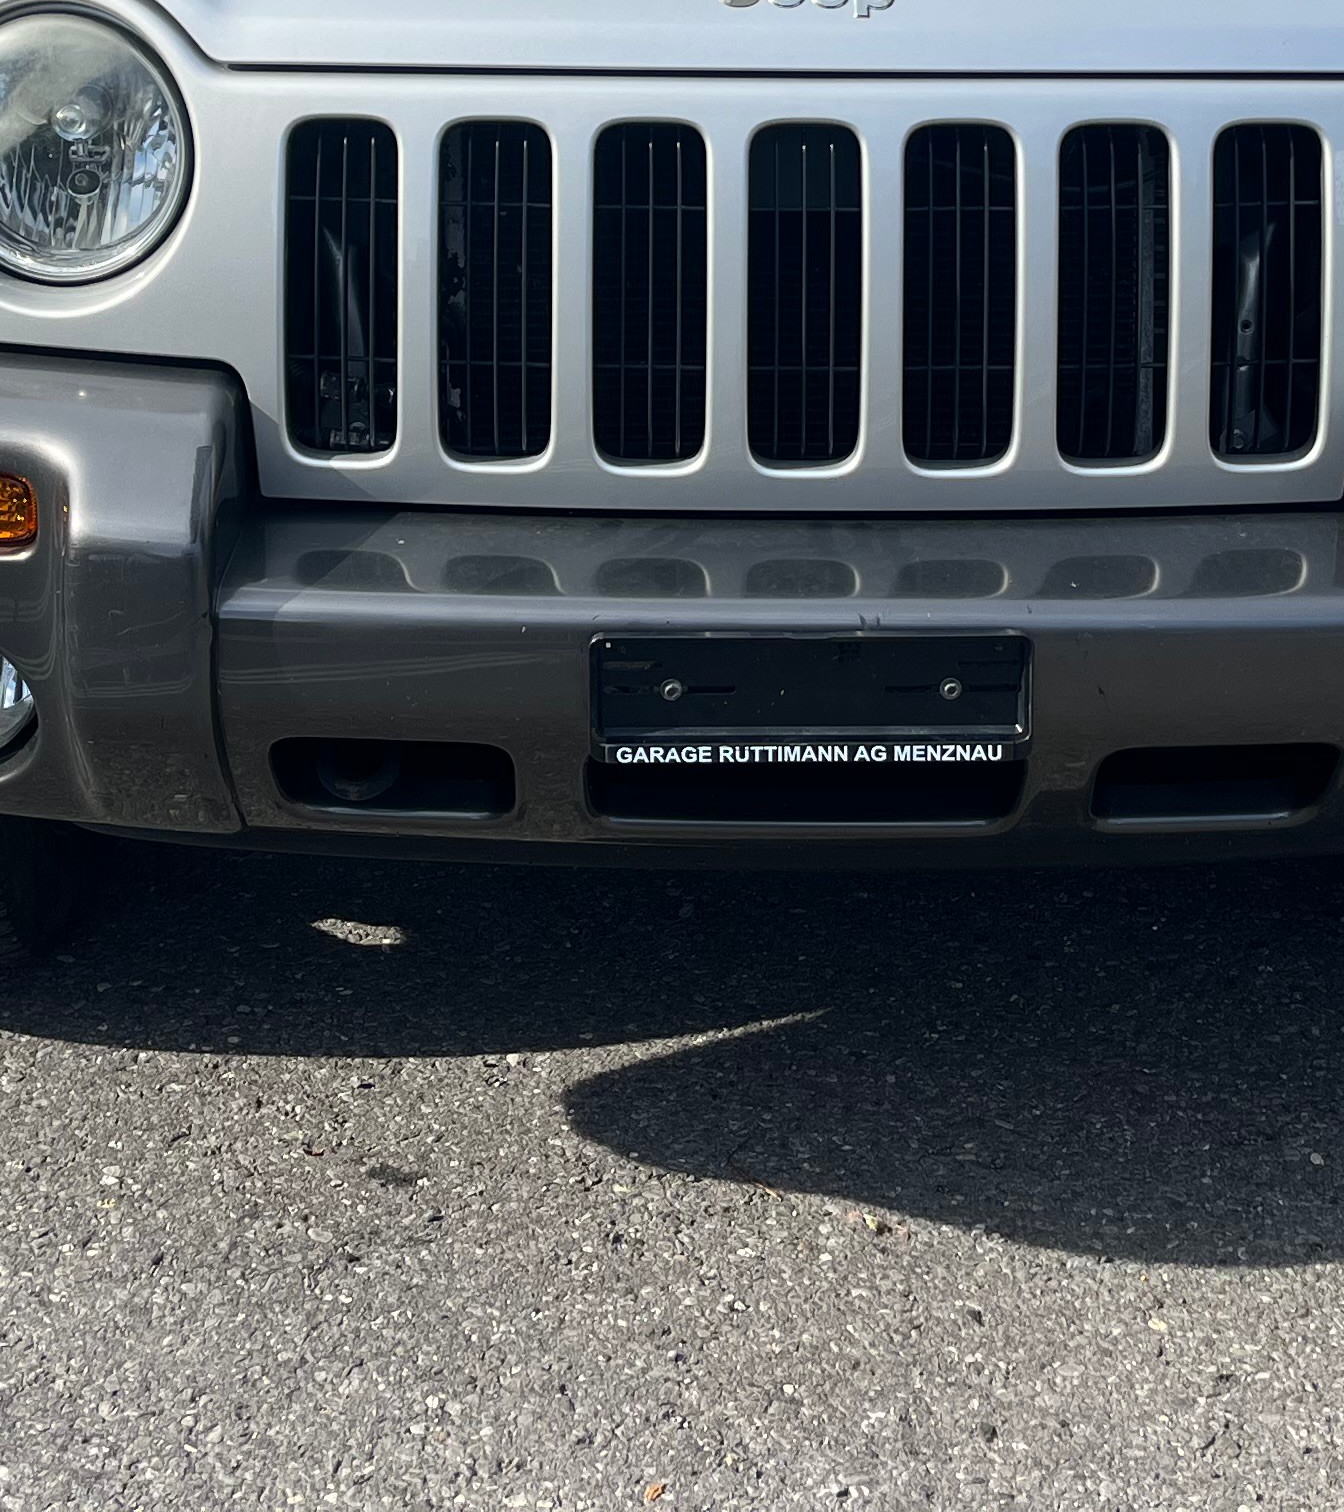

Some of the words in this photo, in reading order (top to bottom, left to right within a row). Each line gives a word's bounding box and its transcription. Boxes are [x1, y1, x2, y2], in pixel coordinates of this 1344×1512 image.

[616, 745, 713, 764] GARAGE
[853, 744, 888, 763] AG
[894, 743, 1003, 762] MENZNAU
